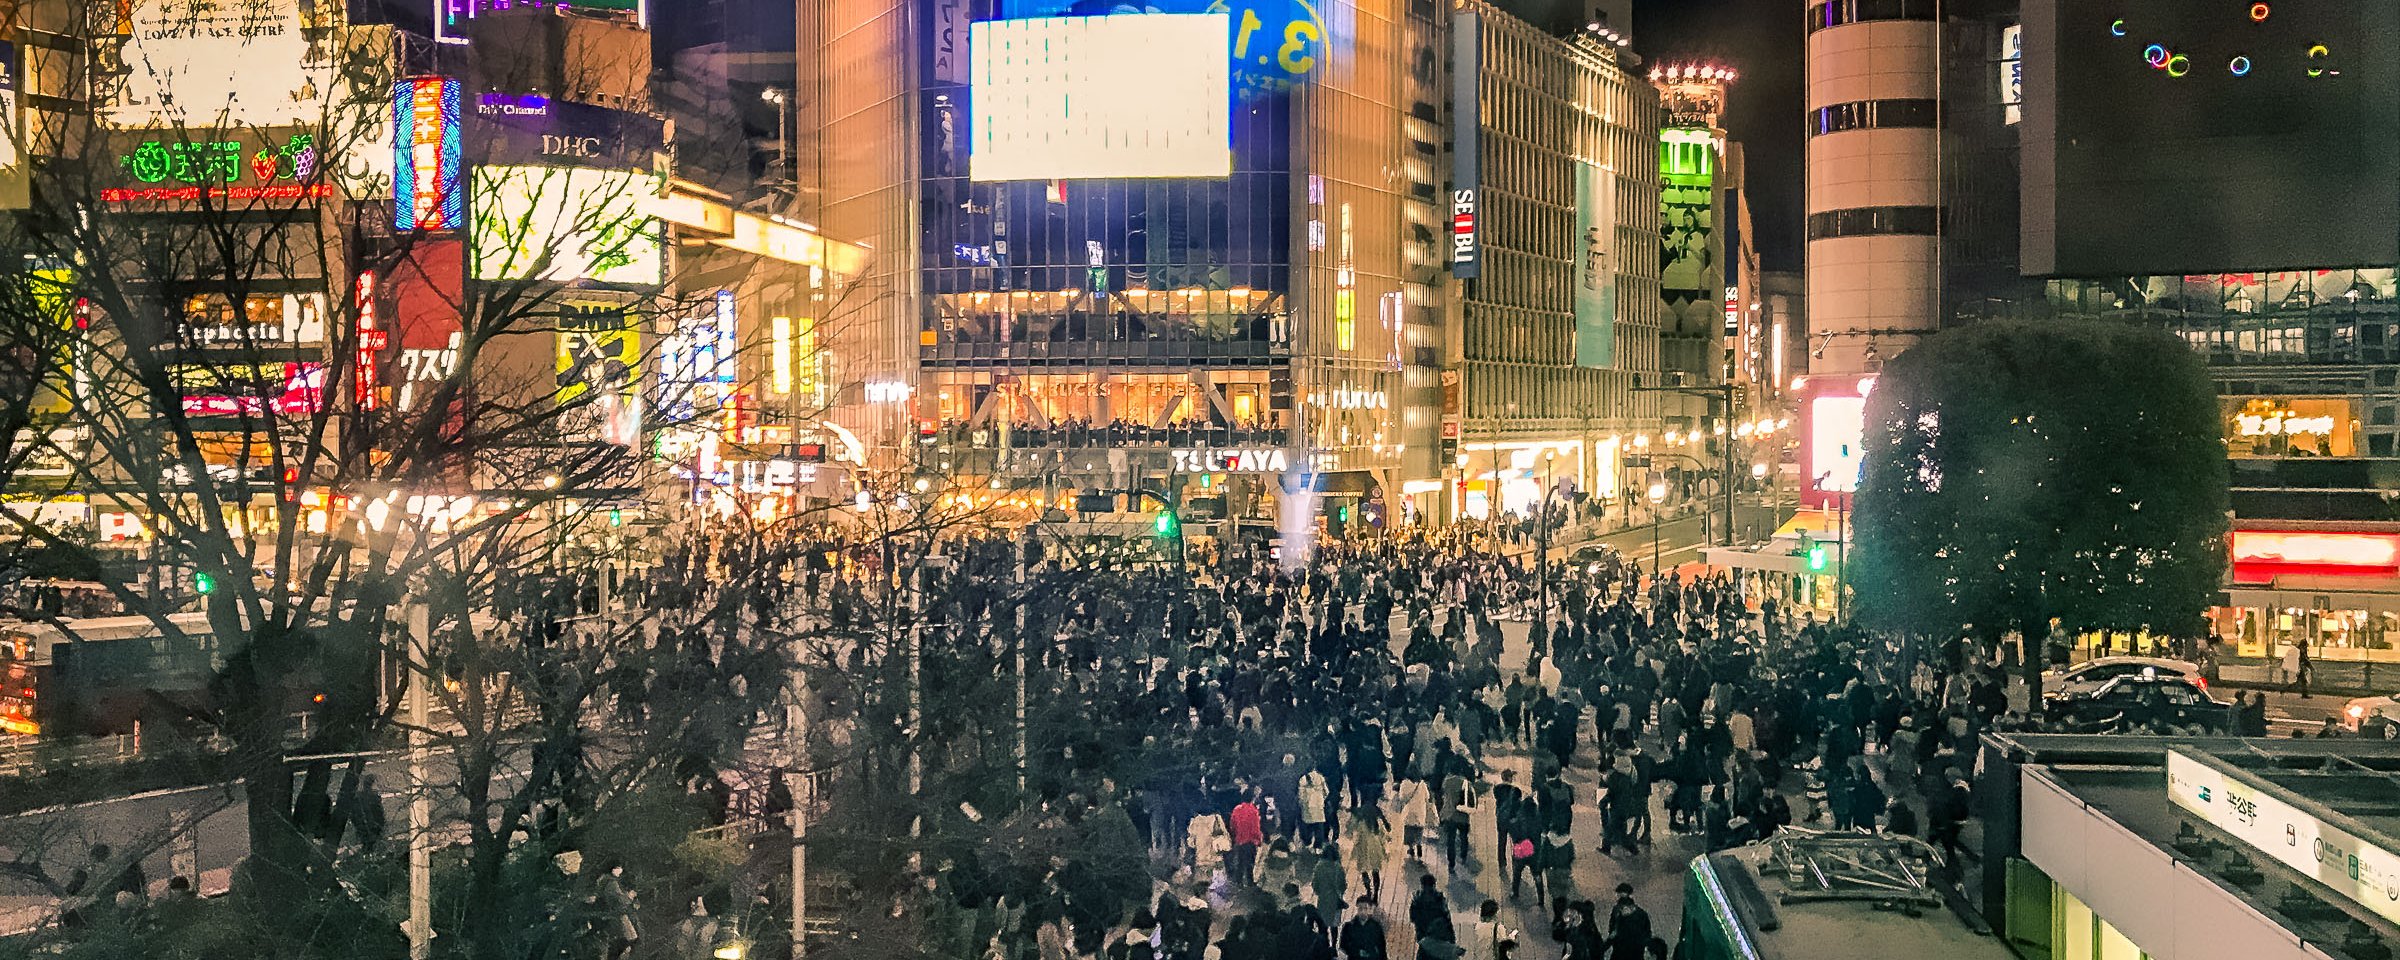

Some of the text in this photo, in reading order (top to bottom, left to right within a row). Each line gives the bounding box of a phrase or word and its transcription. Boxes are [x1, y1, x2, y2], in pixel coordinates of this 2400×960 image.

[541, 134, 601, 158] DHC
[1454, 188, 1474, 264] SEIBU
[560, 332, 605, 359] FX
[1171, 449, 1288, 472] TSUTAYA
